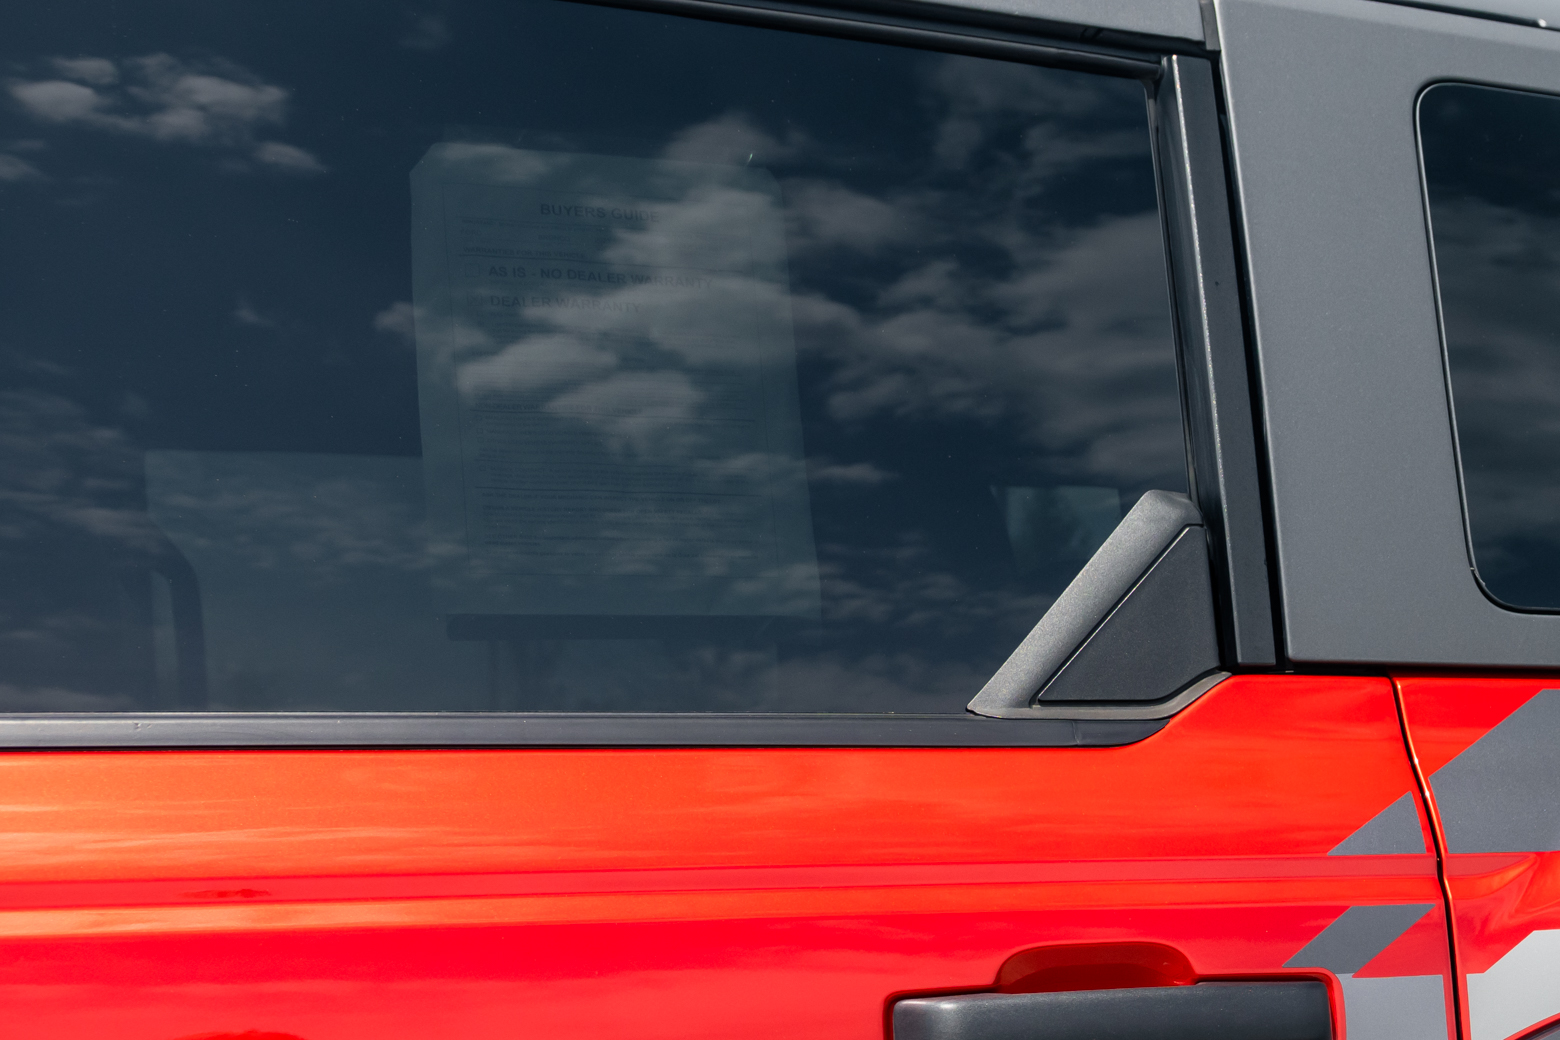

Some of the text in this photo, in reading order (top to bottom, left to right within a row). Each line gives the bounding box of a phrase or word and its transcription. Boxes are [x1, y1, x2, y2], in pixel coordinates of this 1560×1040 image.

[540, 203, 660, 223] BUYERS GUIDE
[489, 265, 508, 278] AS
[512, 266, 526, 278] IS
[540, 267, 563, 280] NO
[567, 269, 627, 285] DEALER
[630, 272, 713, 290] WARRANTY
[490, 295, 641, 314] DEALER WARRANTY
